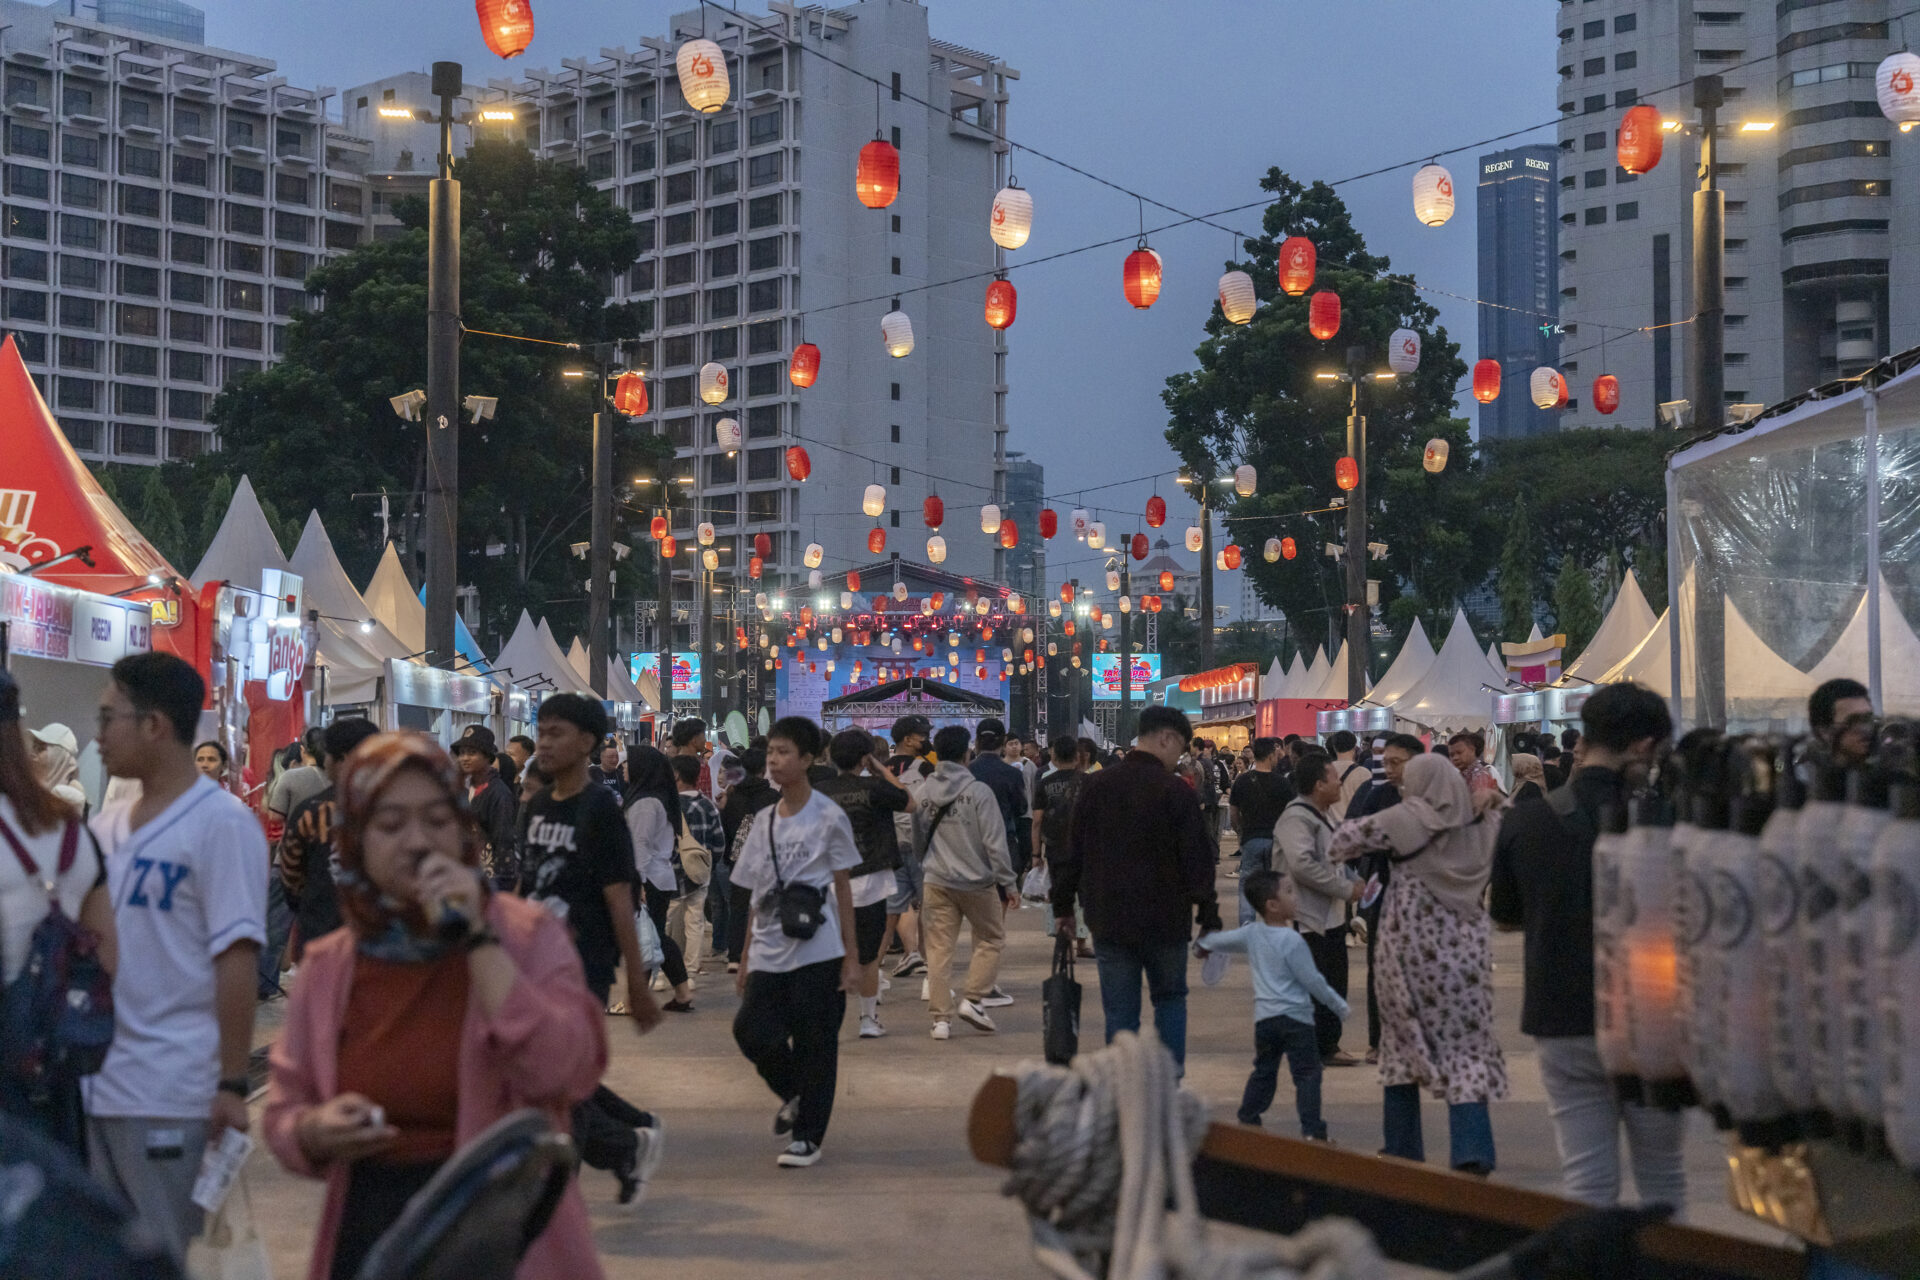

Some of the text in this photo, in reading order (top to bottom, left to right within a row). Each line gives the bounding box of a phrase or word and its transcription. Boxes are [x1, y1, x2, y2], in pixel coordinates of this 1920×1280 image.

[1485, 160, 1513, 173] REGENT
[1525, 157, 1550, 171] REGENT
[268, 626, 304, 699] Tango
[128, 857, 189, 911] ZY
